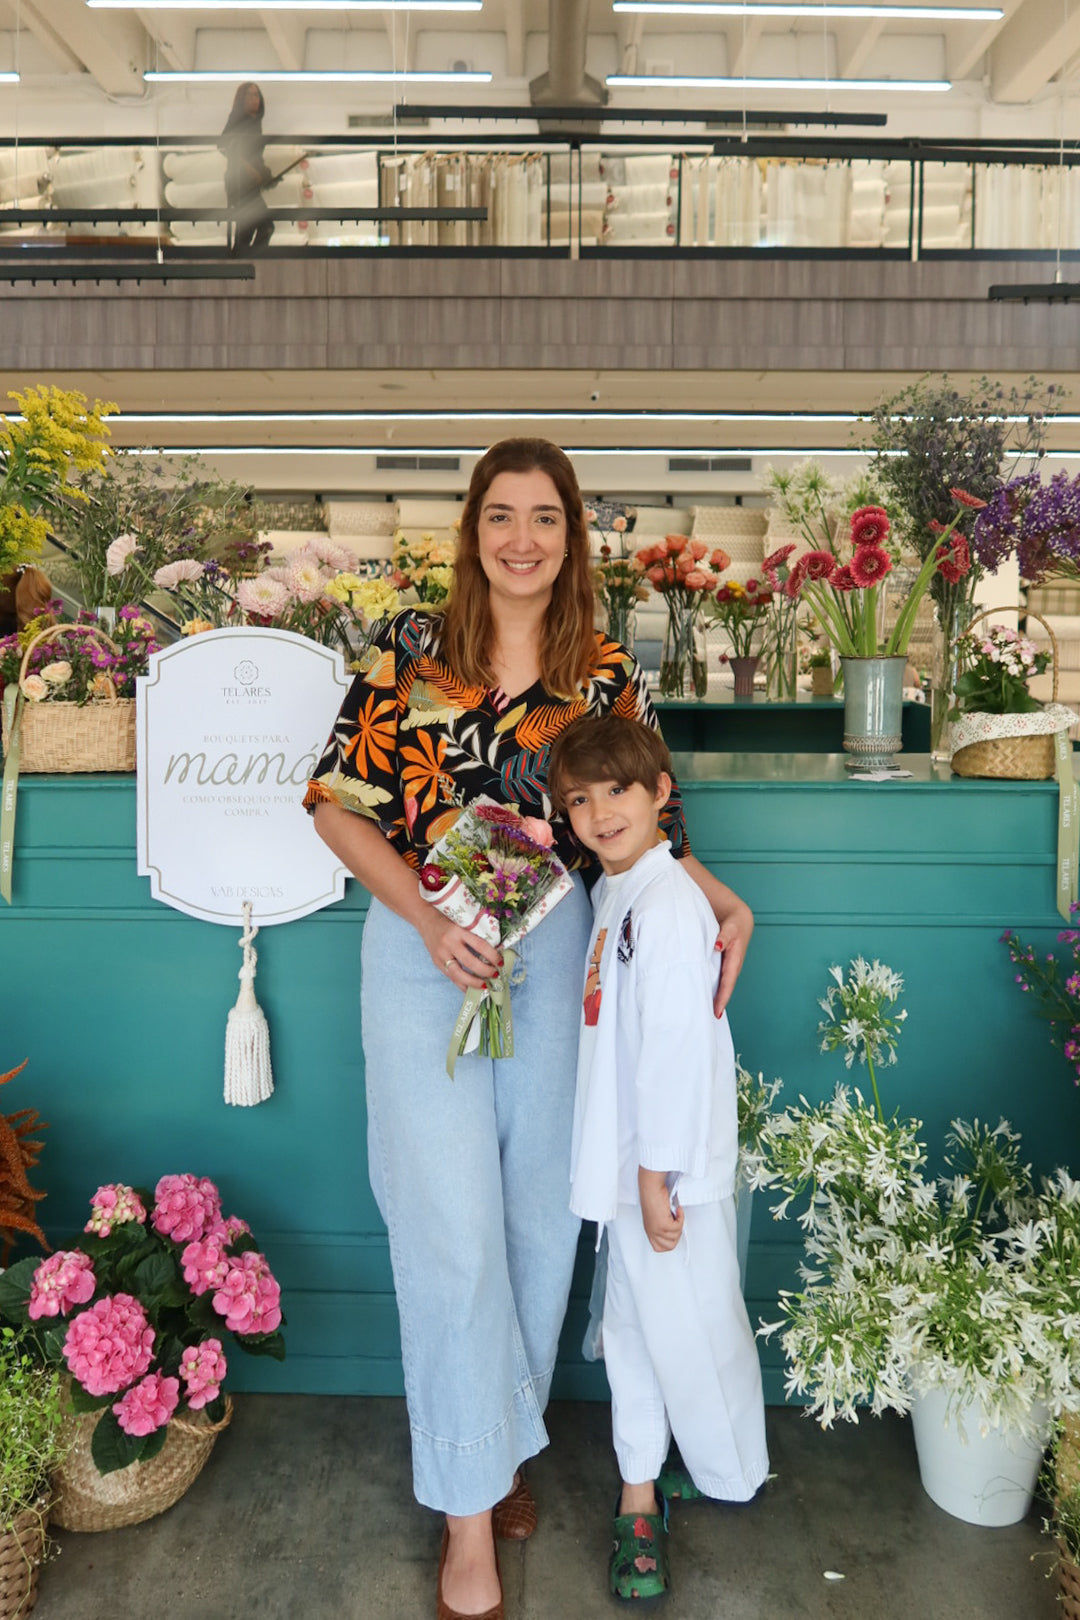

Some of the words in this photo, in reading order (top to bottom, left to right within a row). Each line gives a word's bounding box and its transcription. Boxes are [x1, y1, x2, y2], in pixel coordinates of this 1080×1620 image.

[221, 687, 272, 697] TELARES
[203, 735, 259, 745] BOUQUETS
[262, 735, 291, 744] PARA
[163, 743, 319, 786] mamá
[5, 780, 15, 811] TELARES
[182, 795, 215, 804] COMO
[217, 795, 271, 806] OBSEQUIO
[273, 795, 295, 804] POR
[224, 807, 270, 817] COMPRA
[1063, 796, 1071, 828] TELARES
[2, 841, 10, 872] TELARES
[1062, 858, 1070, 890] TELARES
[455, 1000, 473, 1037] TELARES
